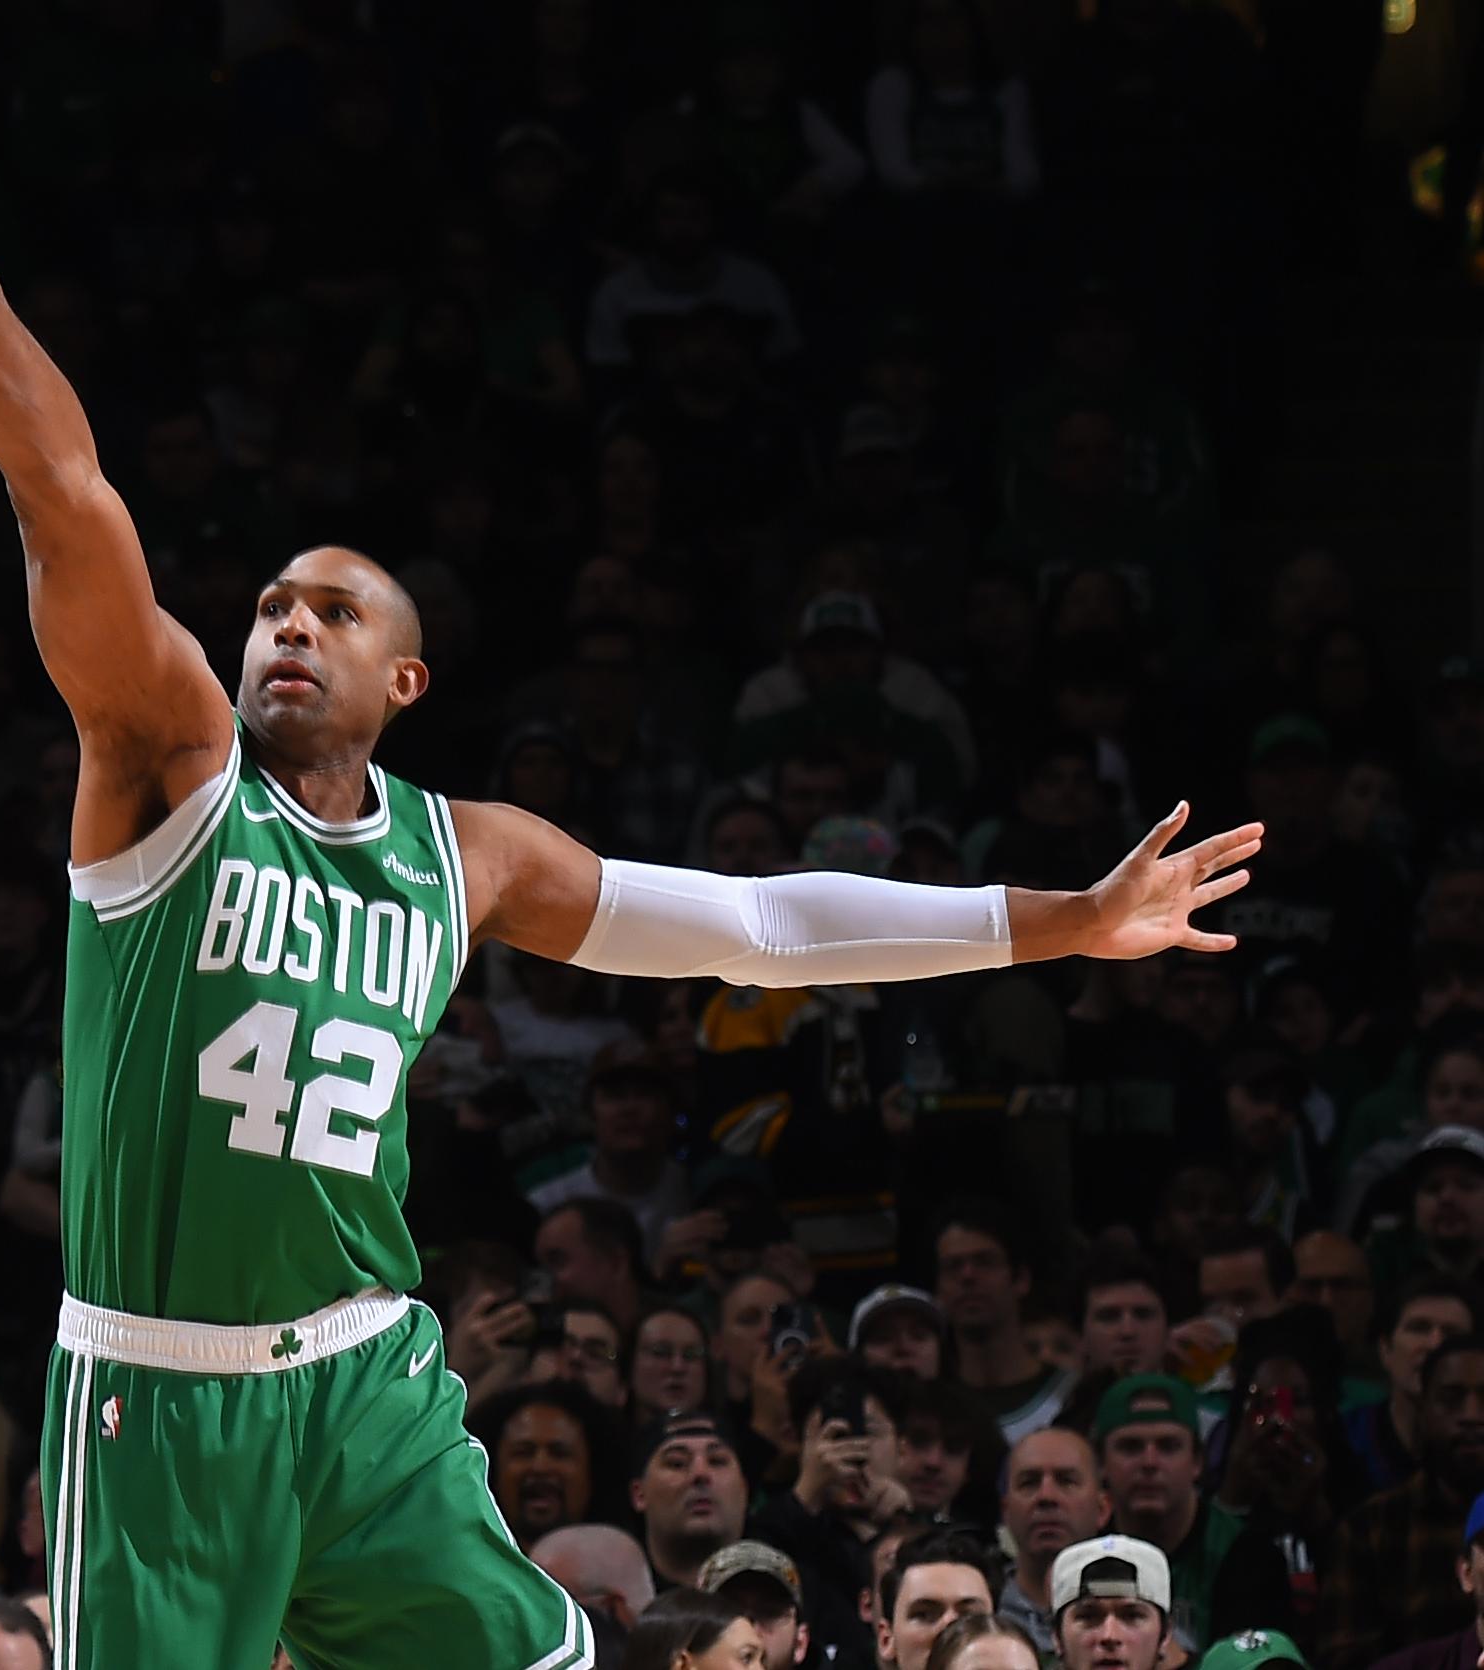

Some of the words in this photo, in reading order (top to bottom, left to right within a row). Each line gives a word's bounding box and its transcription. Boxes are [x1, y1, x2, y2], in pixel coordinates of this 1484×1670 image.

[196, 859, 444, 1035] BOSTON
[382, 851, 441, 886] Amica
[198, 1000, 404, 1178] 42
